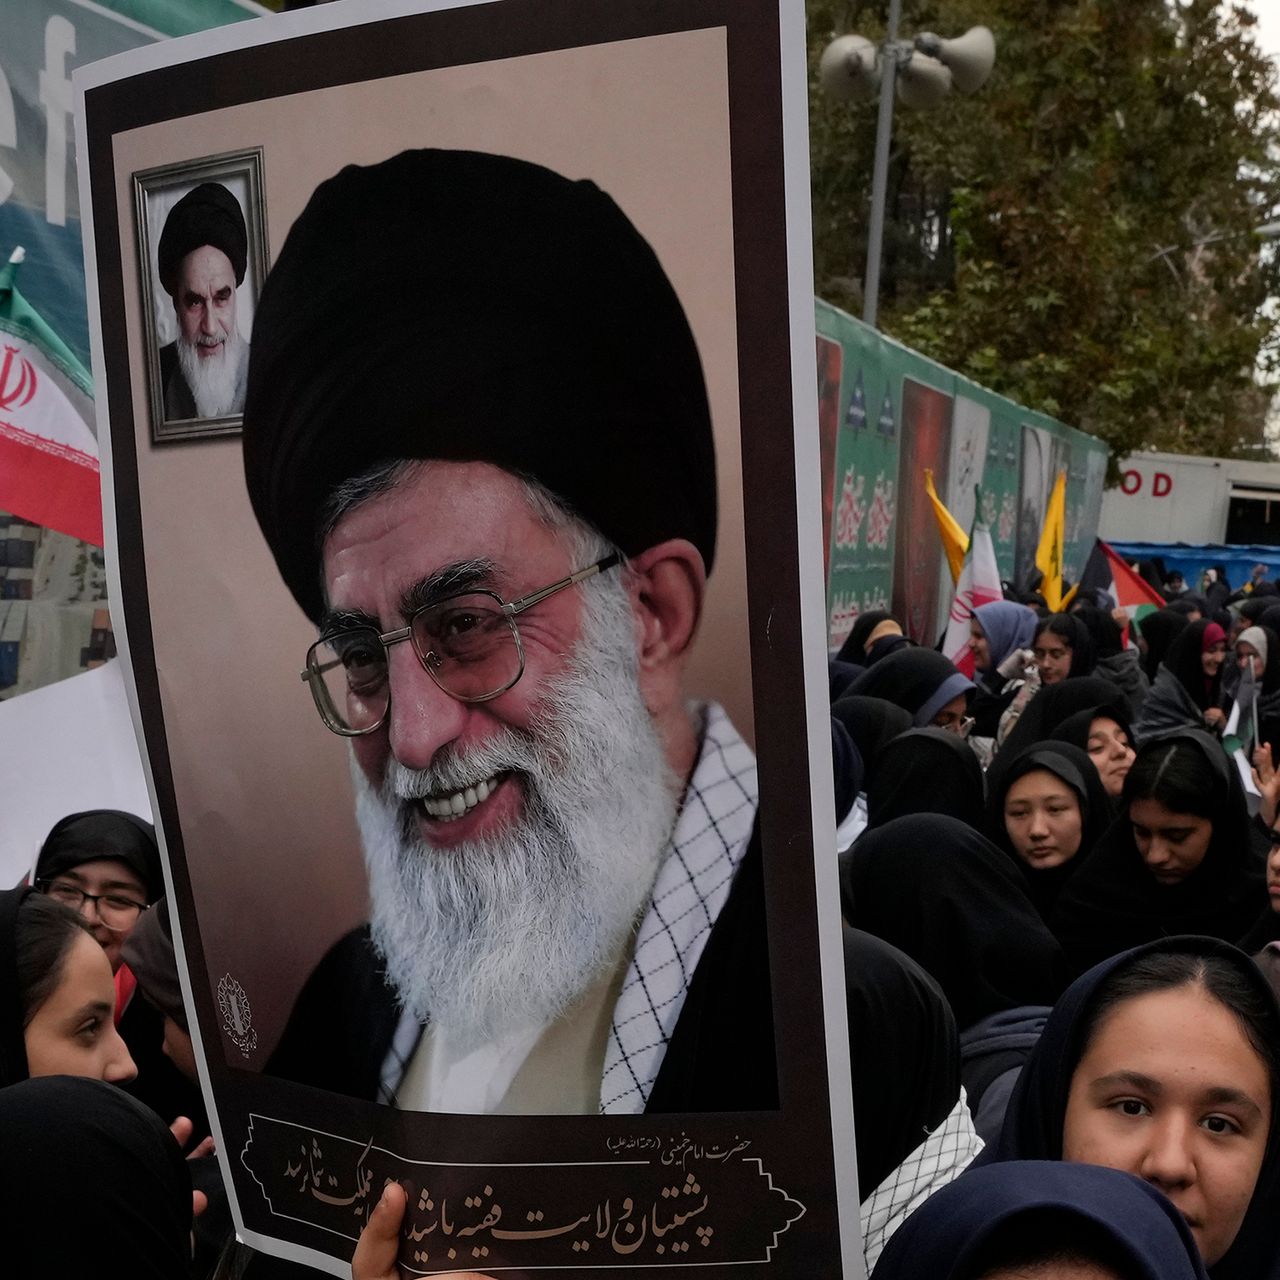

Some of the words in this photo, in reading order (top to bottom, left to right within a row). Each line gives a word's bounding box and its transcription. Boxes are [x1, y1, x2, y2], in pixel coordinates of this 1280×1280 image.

[660, 1130, 692, 1166] خمینی
[682, 1143, 705, 1173] امام
[705, 1134, 754, 1164] حضرت
[456, 1183, 503, 1259] فقیه
[611, 1171, 715, 1256] پشتیبان
